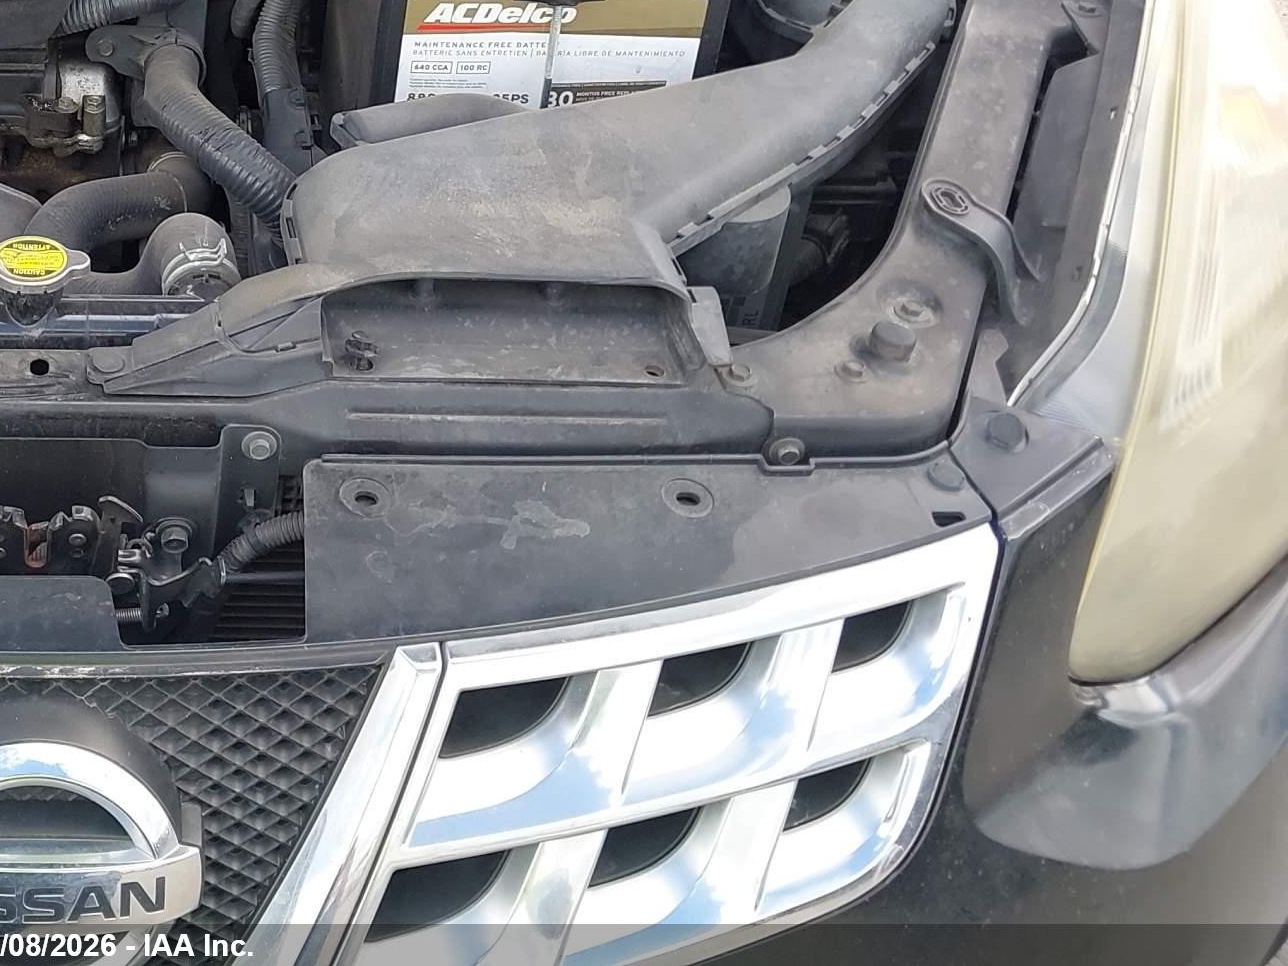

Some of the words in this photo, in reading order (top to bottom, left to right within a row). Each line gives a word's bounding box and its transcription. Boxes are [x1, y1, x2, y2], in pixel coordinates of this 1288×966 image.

[423, 2, 577, 24] ACDelco
[414, 41, 484, 49] MAINTENANCE
[12, 243, 51, 251] ATTENTION
[13, 268, 46, 276] CAUTION
